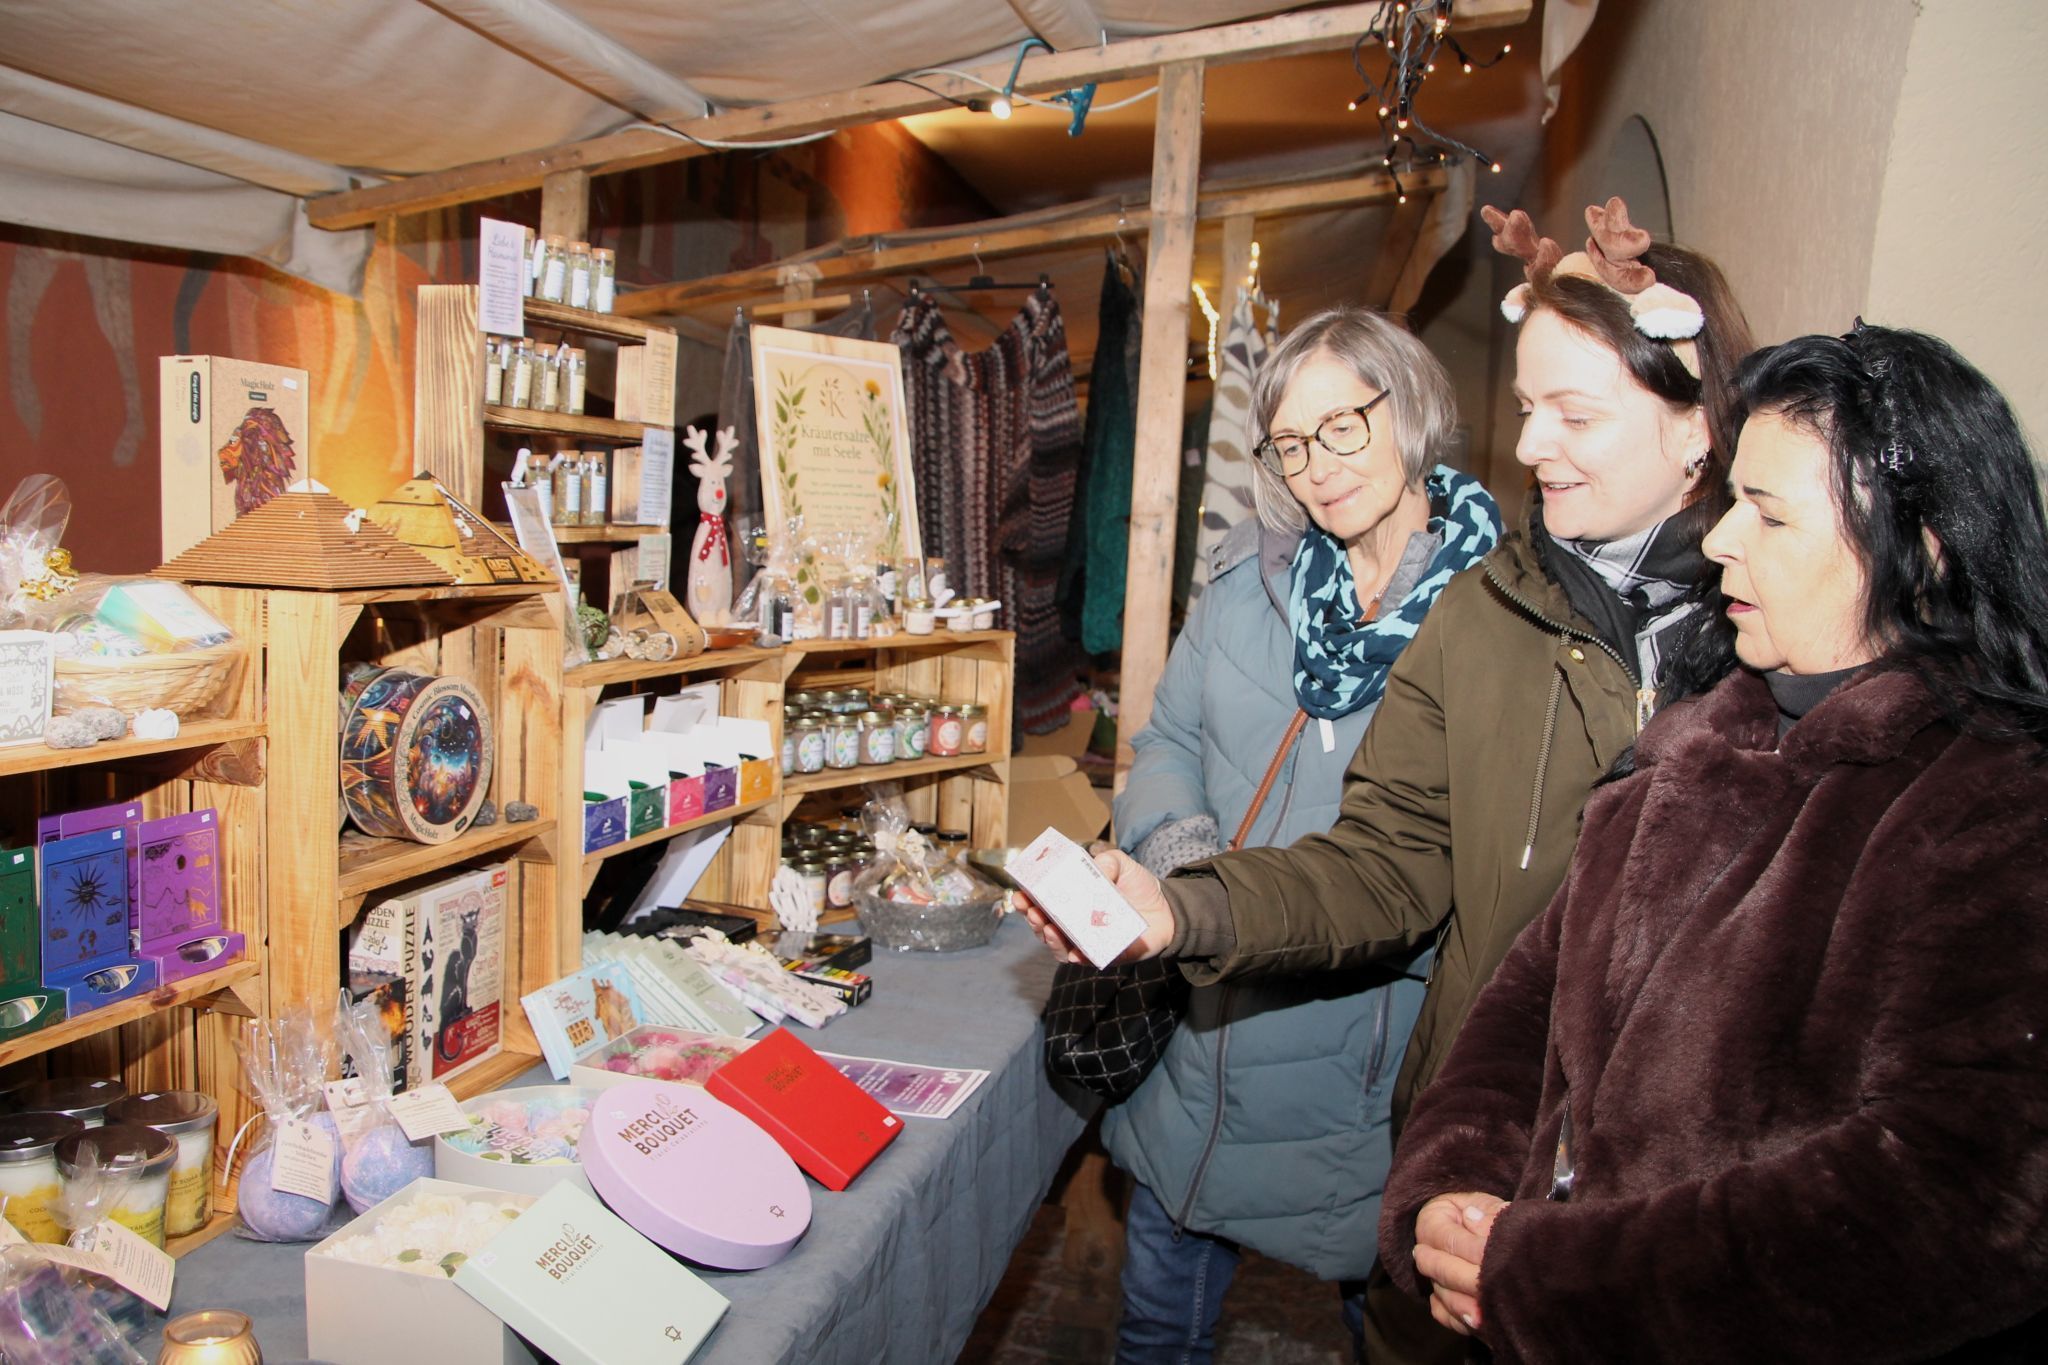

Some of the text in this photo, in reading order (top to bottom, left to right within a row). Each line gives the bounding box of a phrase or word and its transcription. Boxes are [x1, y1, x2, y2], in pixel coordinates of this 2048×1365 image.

[801, 425, 871, 444] Kräutersalze
[813, 445, 863, 460] mit Seele
[365, 917, 390, 929] UZZLE
[370, 907, 395, 918] ODEN
[404, 906, 416, 974] PUZZLE
[617, 1109, 666, 1142] MERCI
[634, 1108, 700, 1155] BOUQUET
[535, 1237, 570, 1270] MERCI
[548, 1234, 597, 1281] BOUQUET
